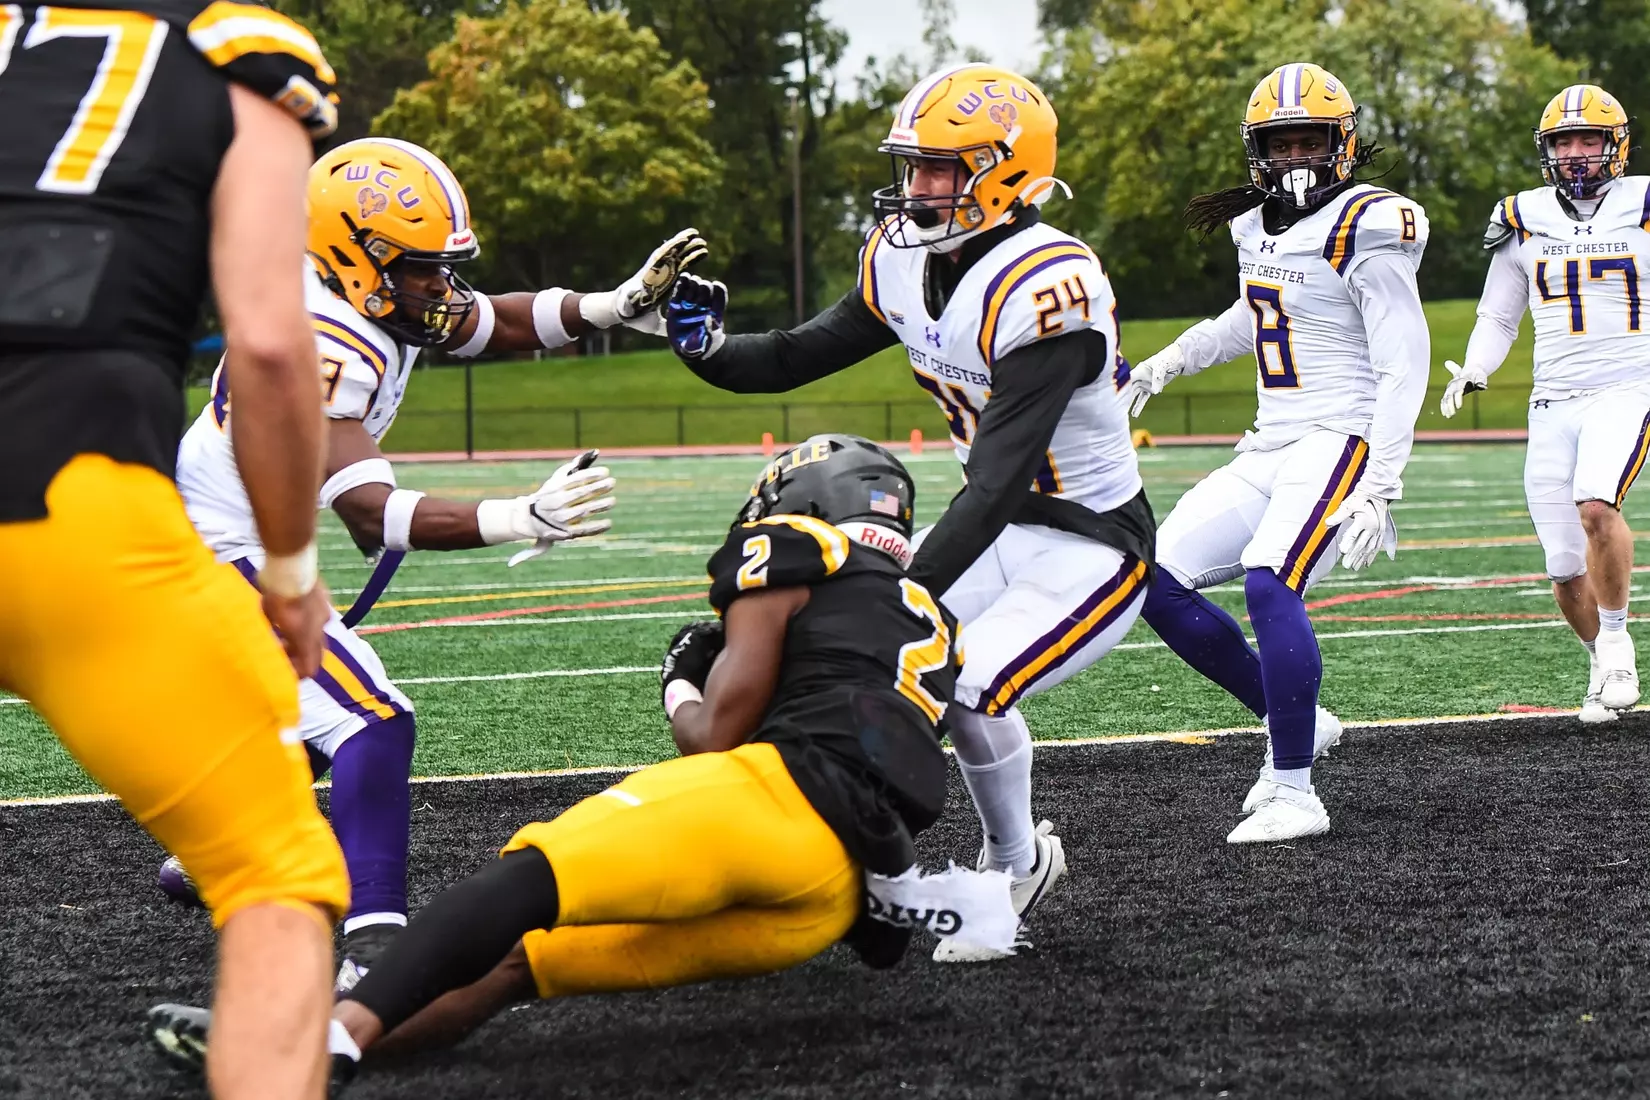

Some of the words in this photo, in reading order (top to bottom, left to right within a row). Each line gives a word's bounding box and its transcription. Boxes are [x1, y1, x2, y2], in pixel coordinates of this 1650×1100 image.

[957, 83, 1029, 116] WCU
[346, 165, 420, 209] WCU
[1398, 206, 1416, 243] 8
[1542, 244, 1570, 256] WEST
[1576, 242, 1629, 254] CHESTER
[1257, 264, 1305, 284] CHESTER
[1535, 254, 1642, 335] 47
[1032, 273, 1091, 338] 24
[1246, 279, 1303, 390] 8
[930, 357, 992, 387] CHESTER
[736, 533, 772, 591] 2
[894, 577, 950, 727] 2
